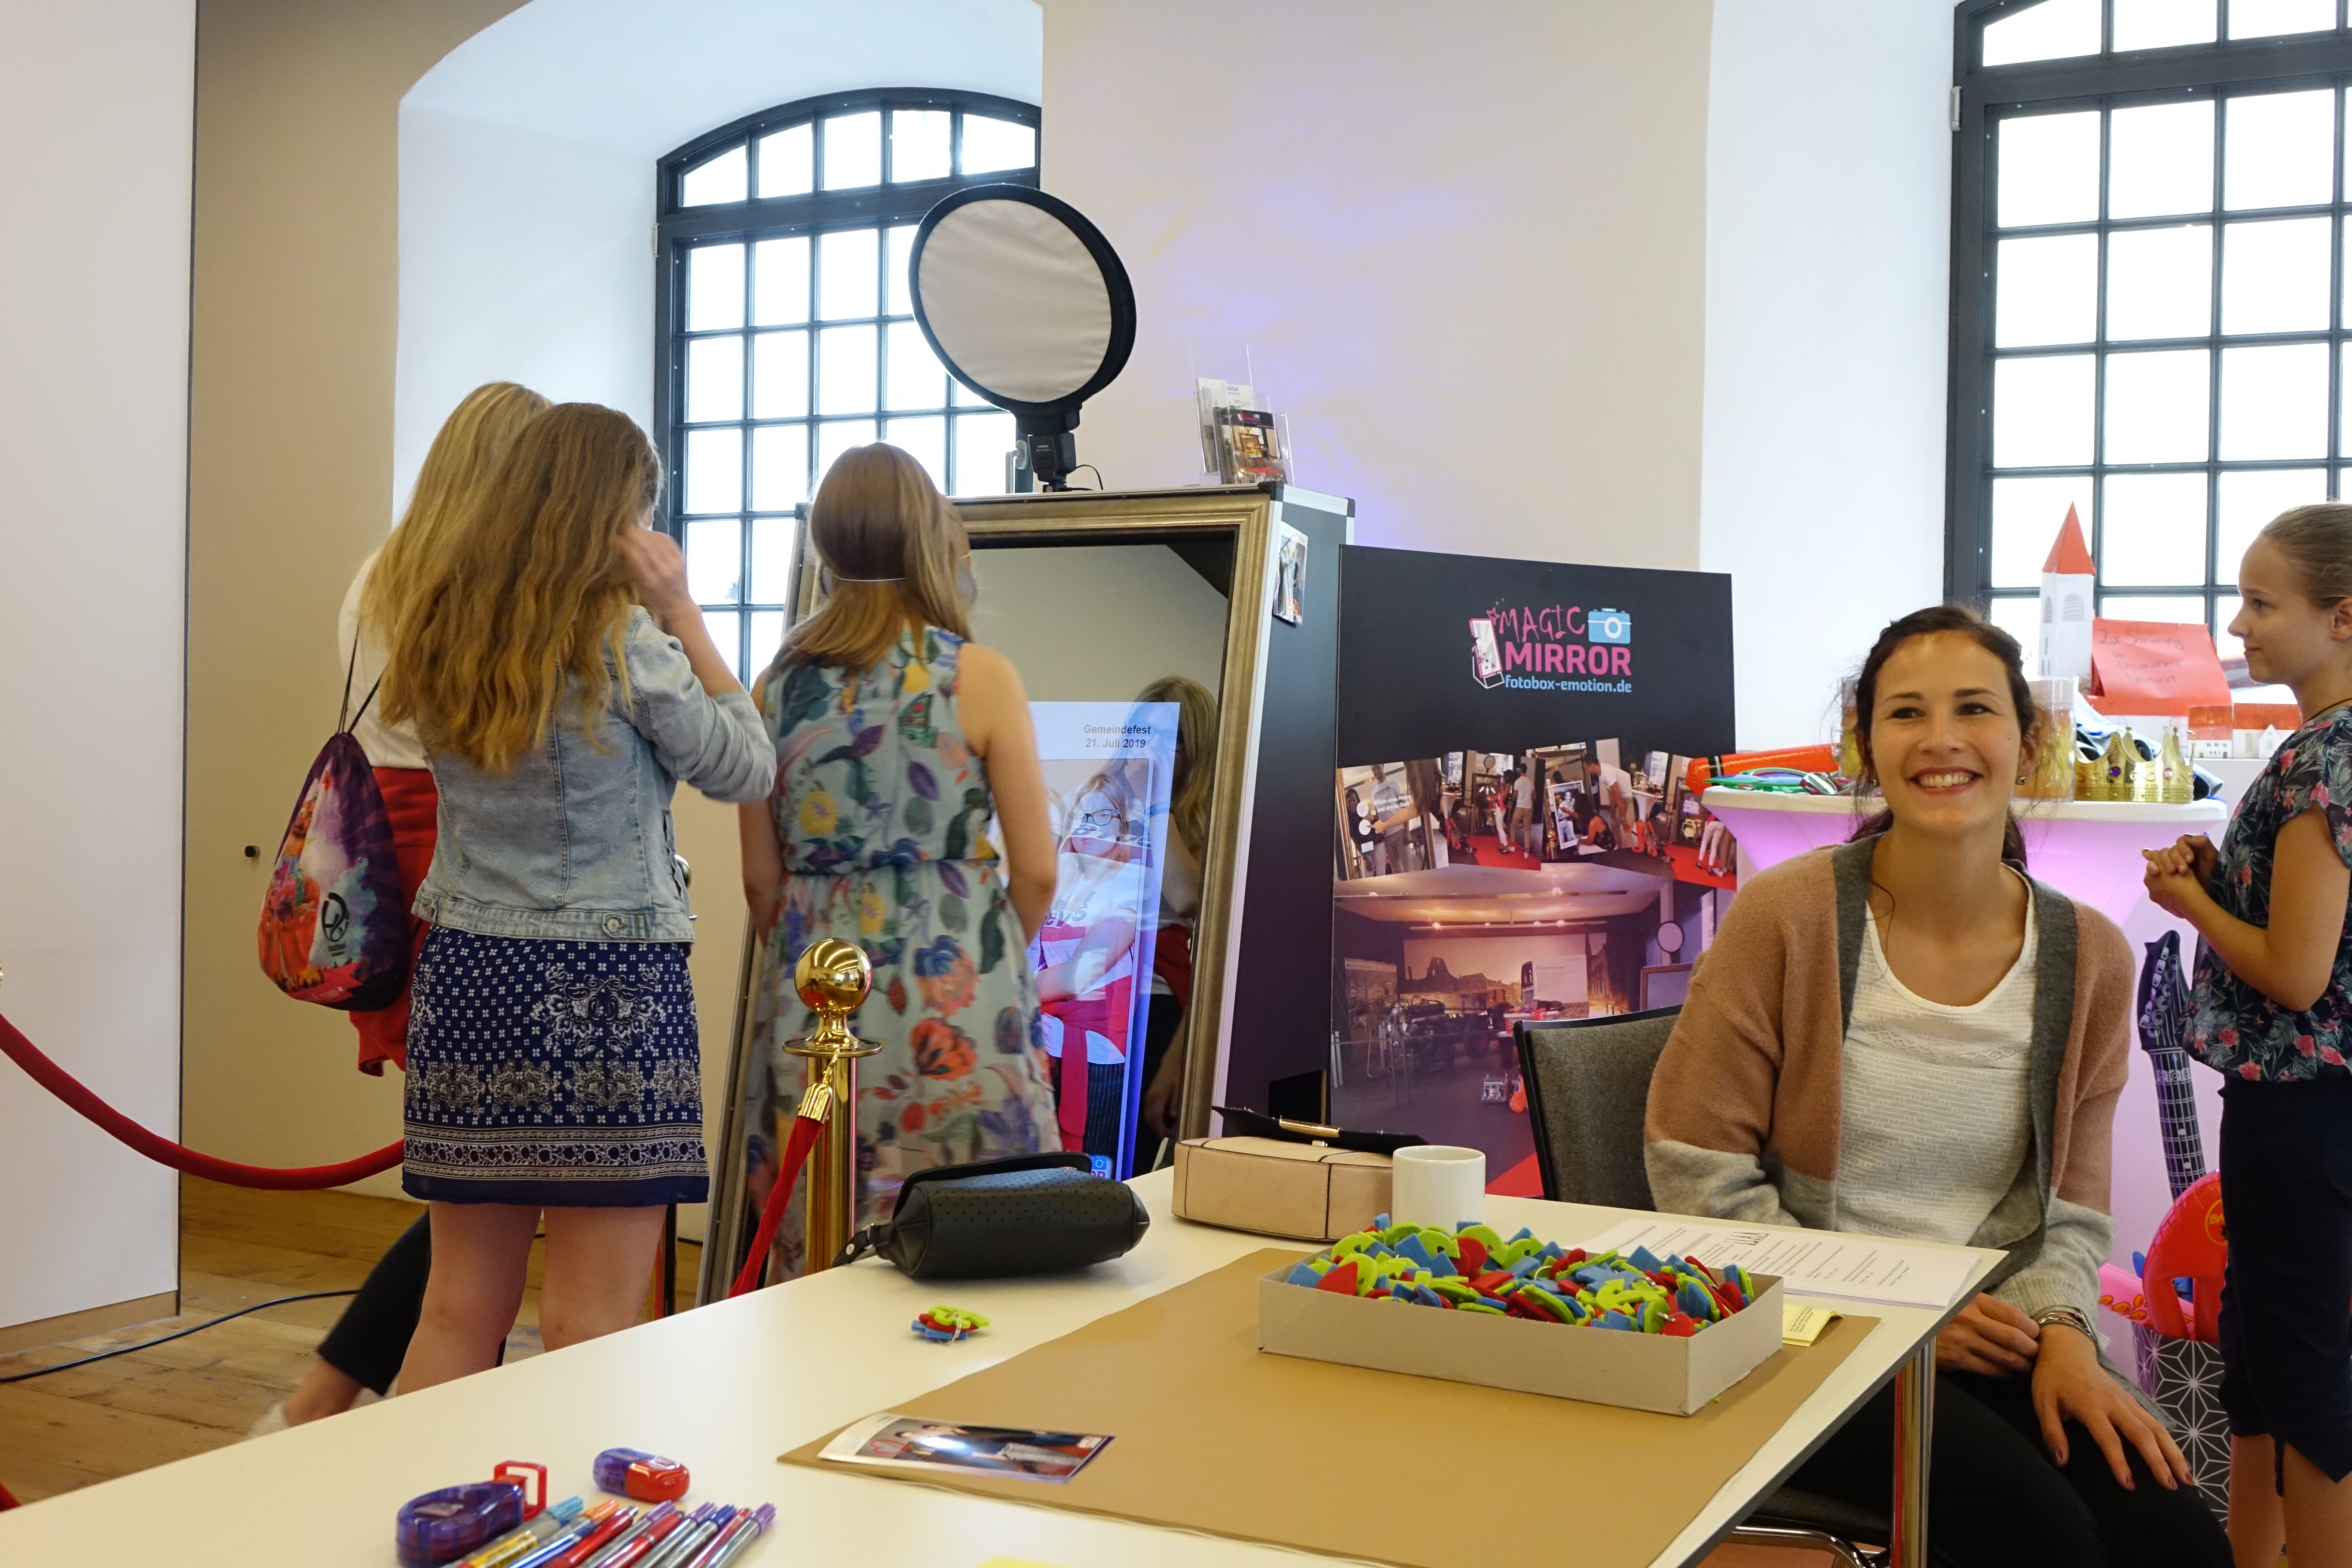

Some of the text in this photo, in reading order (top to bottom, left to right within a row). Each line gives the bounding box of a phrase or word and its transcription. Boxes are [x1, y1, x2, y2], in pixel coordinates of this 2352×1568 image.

[1498, 604, 1586, 643] MAGIC
[1505, 642, 1632, 676] MIRROR
[1505, 674, 1632, 693] fotobox-emotion.de
[1084, 724, 1151, 734] Gemeindefest
[1085, 738, 1146, 748] 21. Juli 2019
